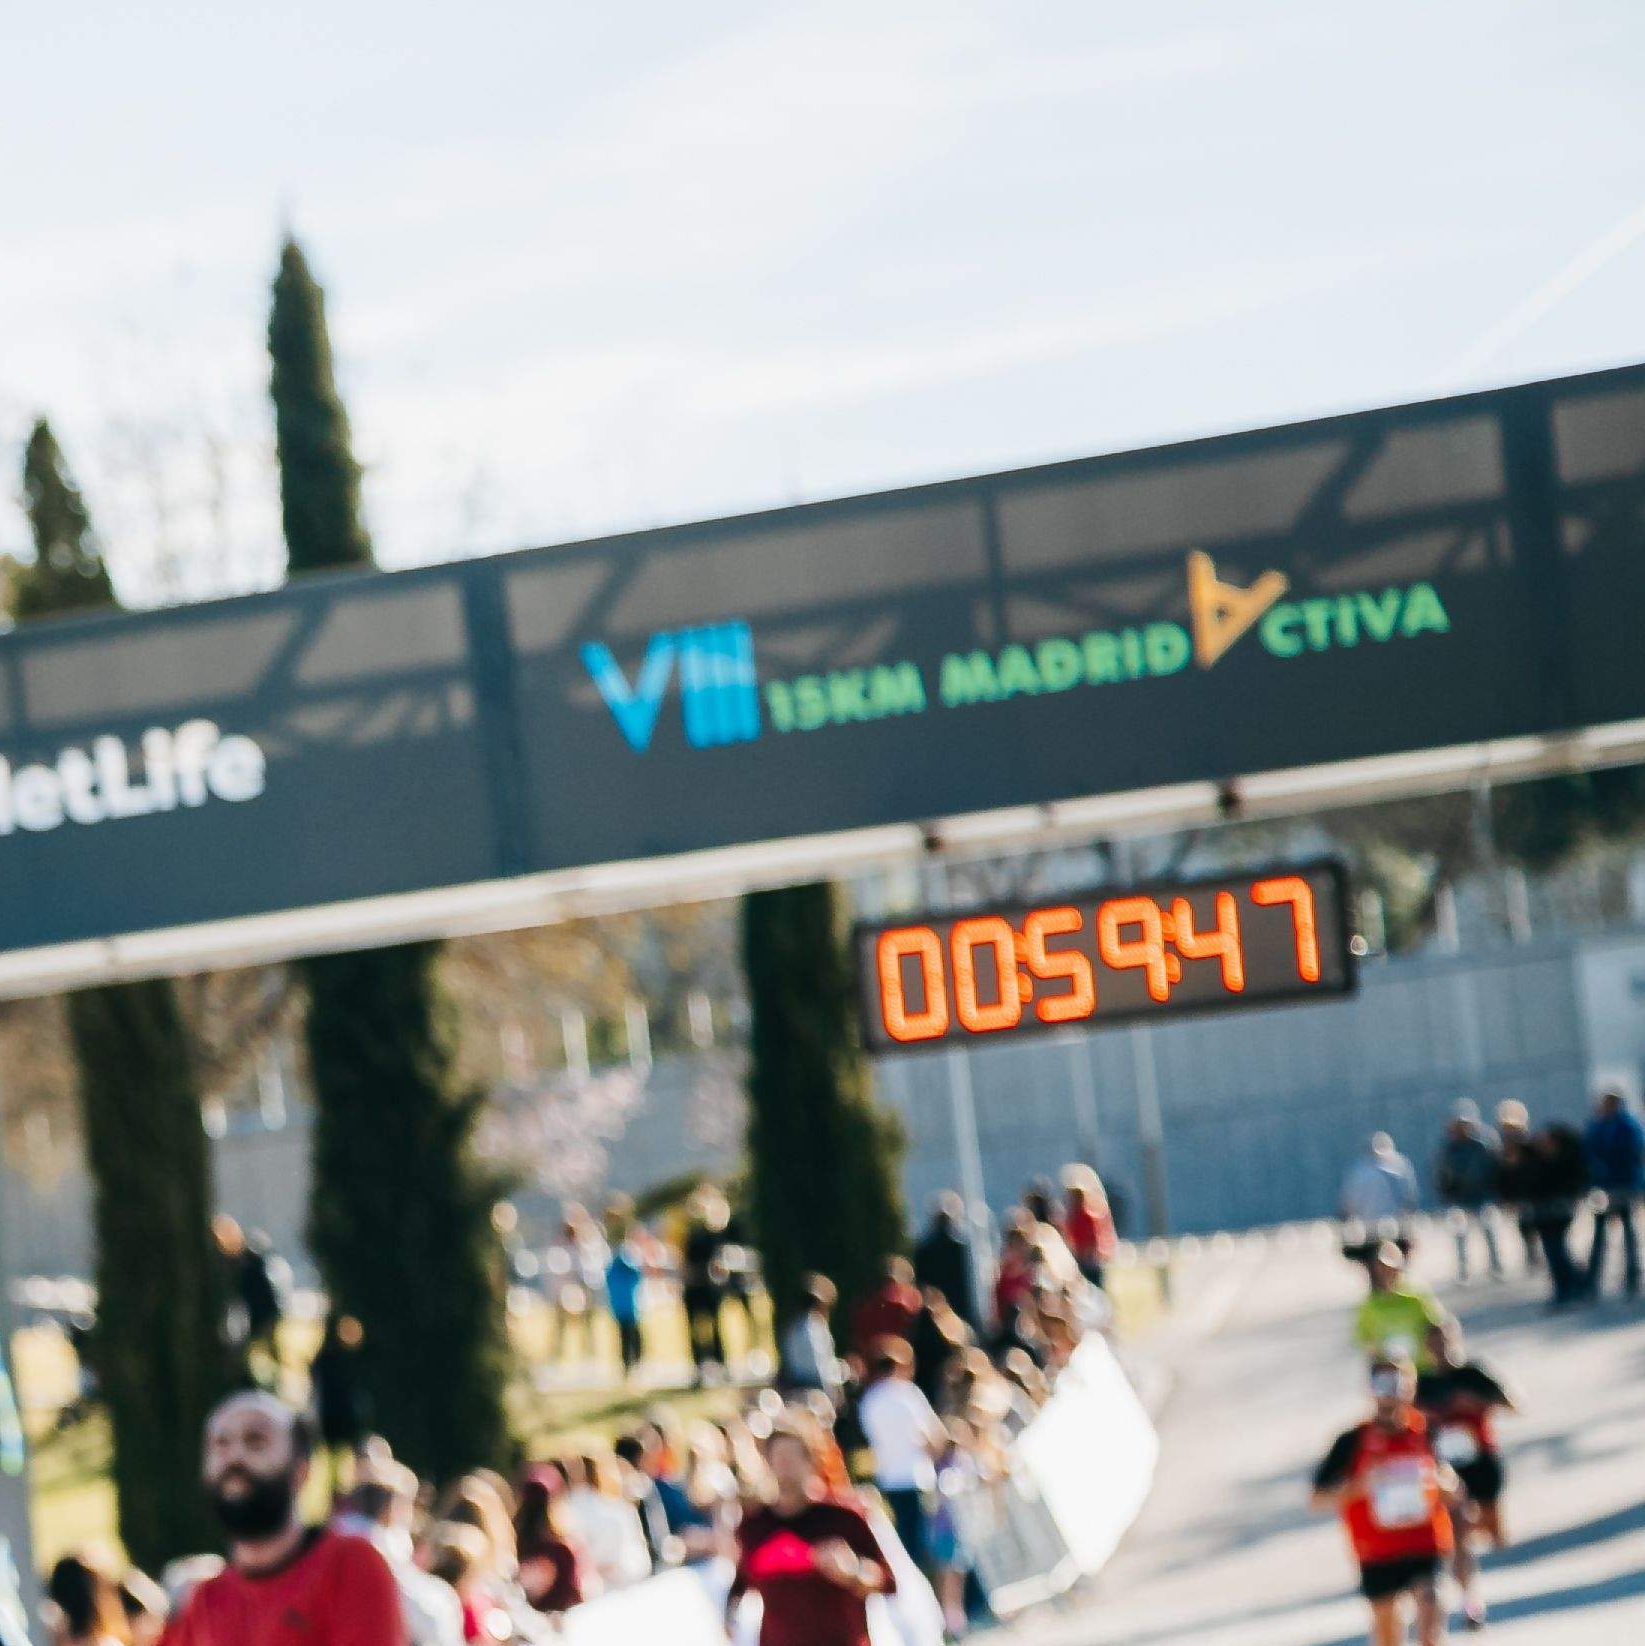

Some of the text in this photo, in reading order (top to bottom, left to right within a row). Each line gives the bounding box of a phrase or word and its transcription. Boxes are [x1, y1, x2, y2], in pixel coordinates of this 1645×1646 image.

[579, 618, 762, 754] VIII
[765, 661, 926, 733] 15KM
[939, 621, 1192, 707] MADRID
